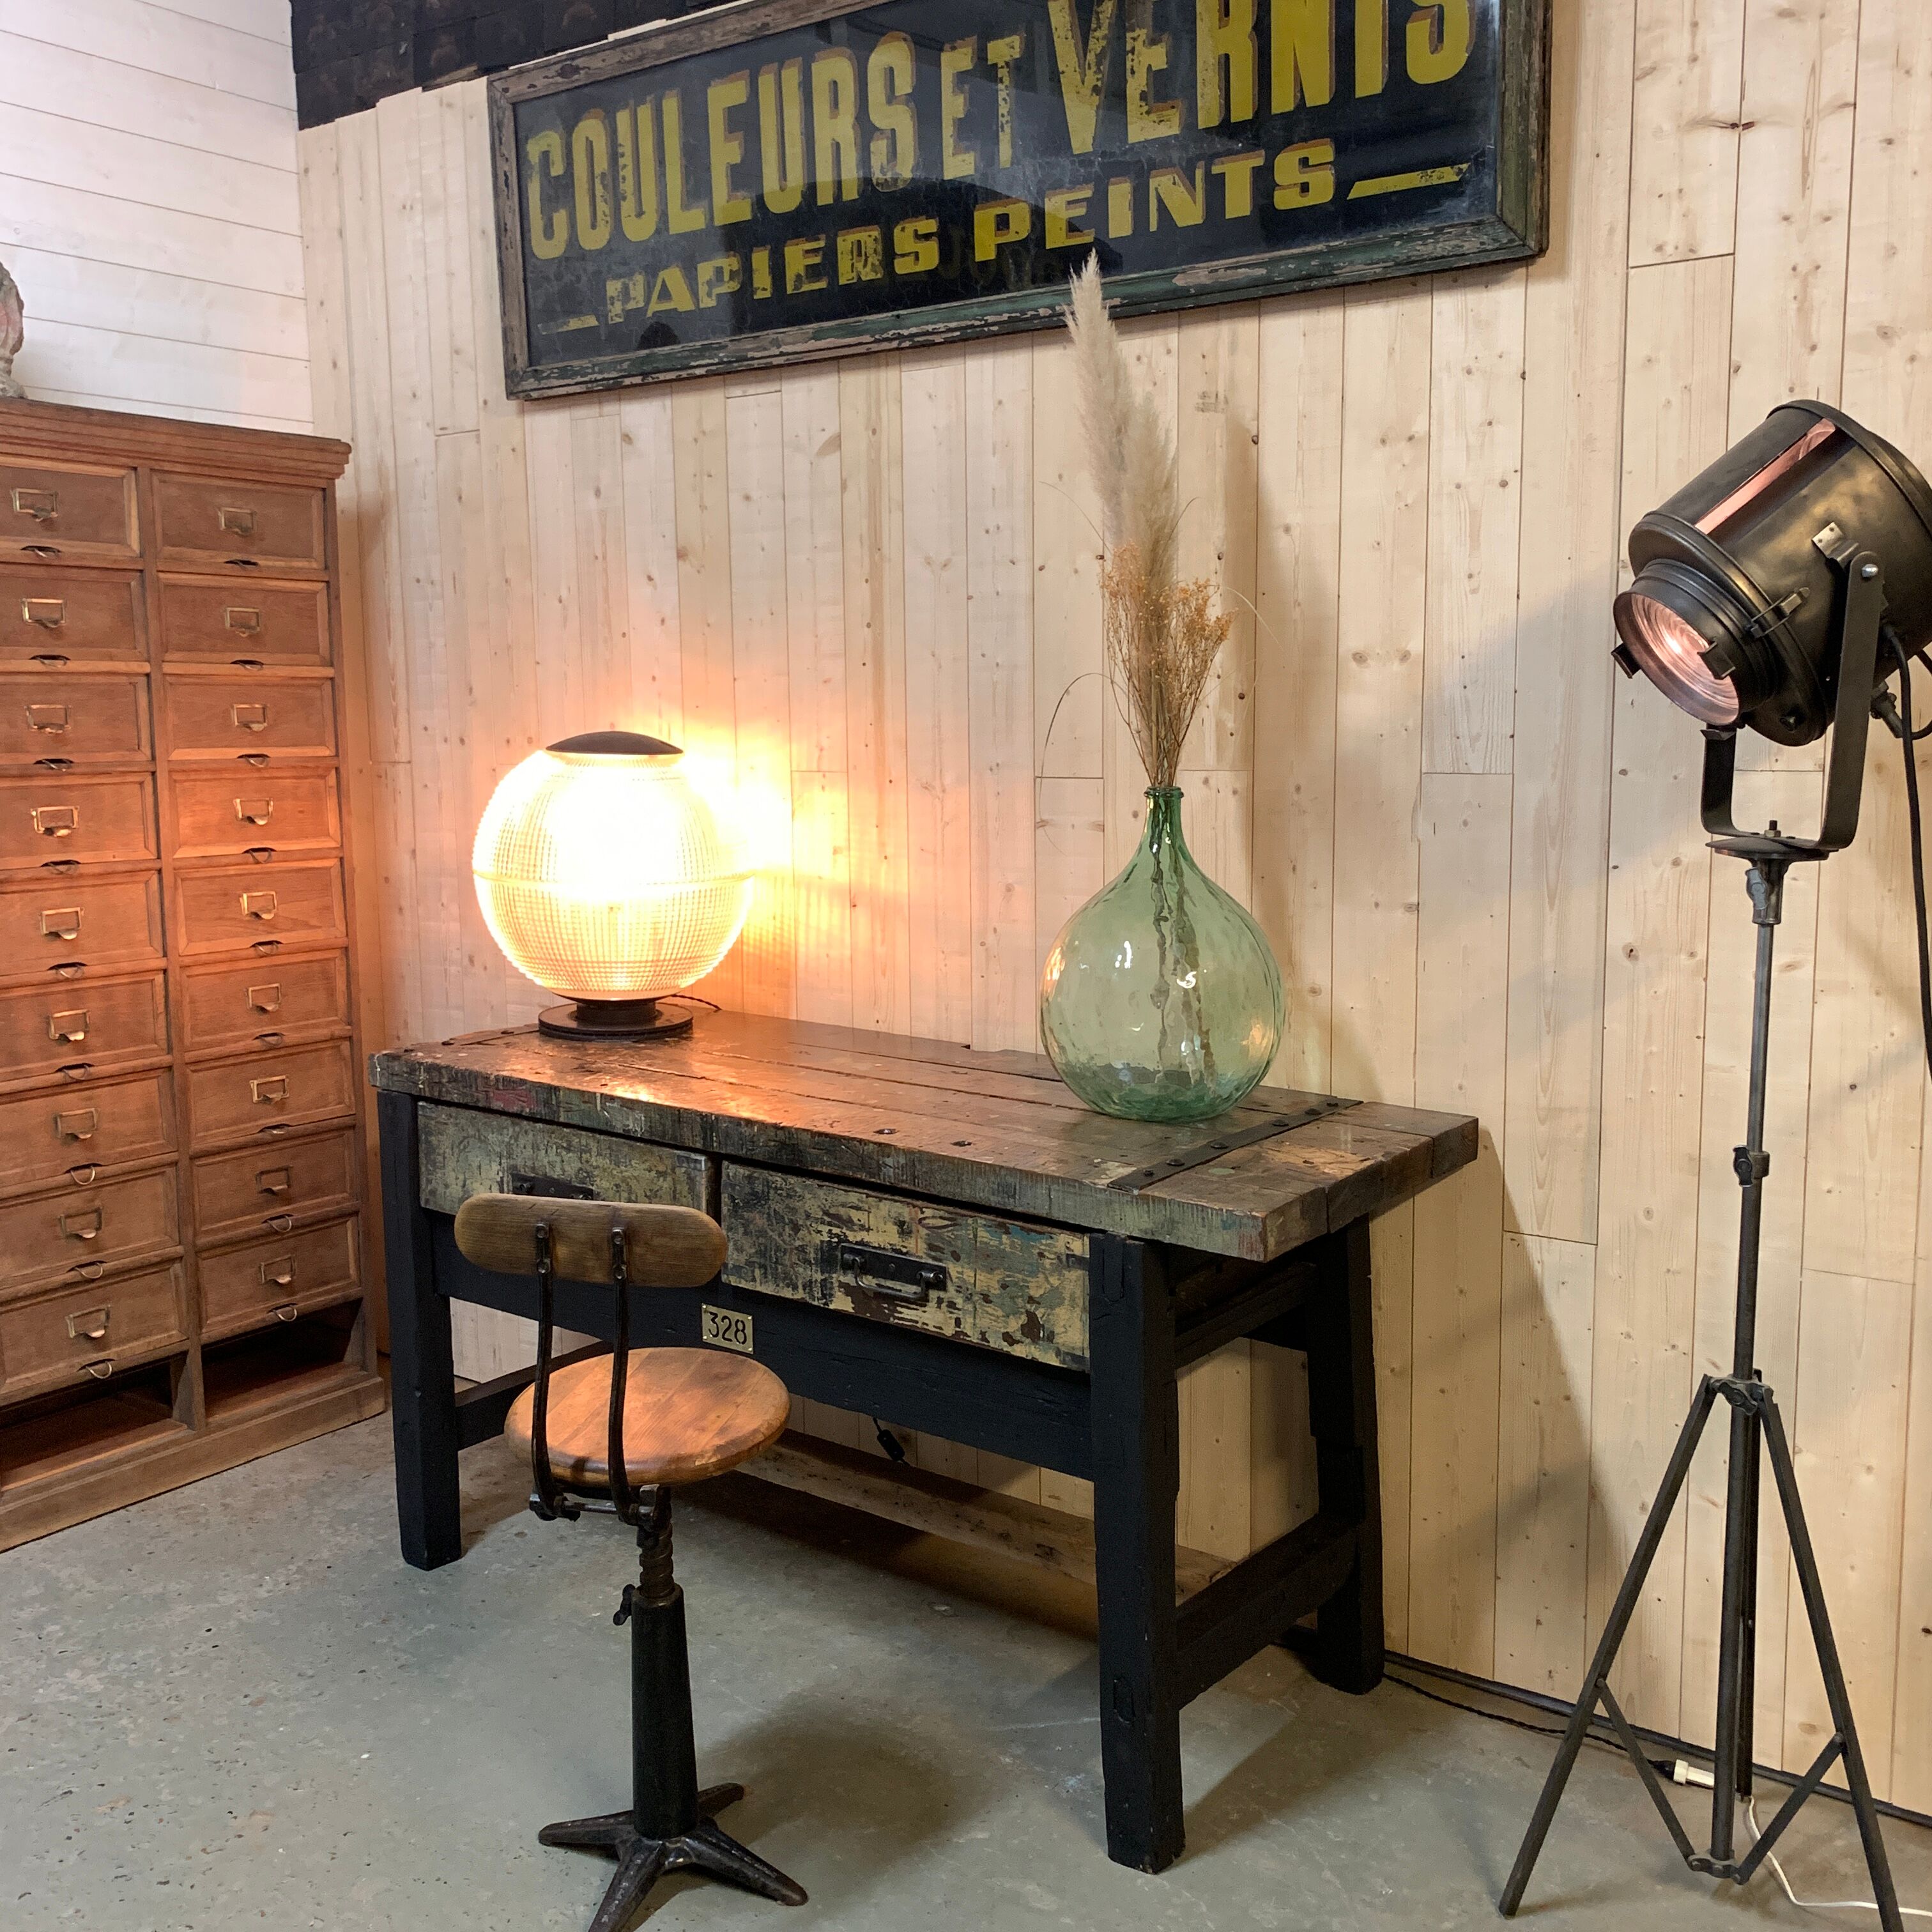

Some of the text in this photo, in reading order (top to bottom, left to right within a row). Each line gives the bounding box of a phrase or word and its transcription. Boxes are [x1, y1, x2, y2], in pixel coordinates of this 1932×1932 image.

[526, 31, 916, 259] COULEURS
[941, 34, 1023, 180] ET
[606, 216, 940, 324] PAPIERS
[974, 138, 1336, 262] PEINTS
[708, 1311, 747, 1345] 328
